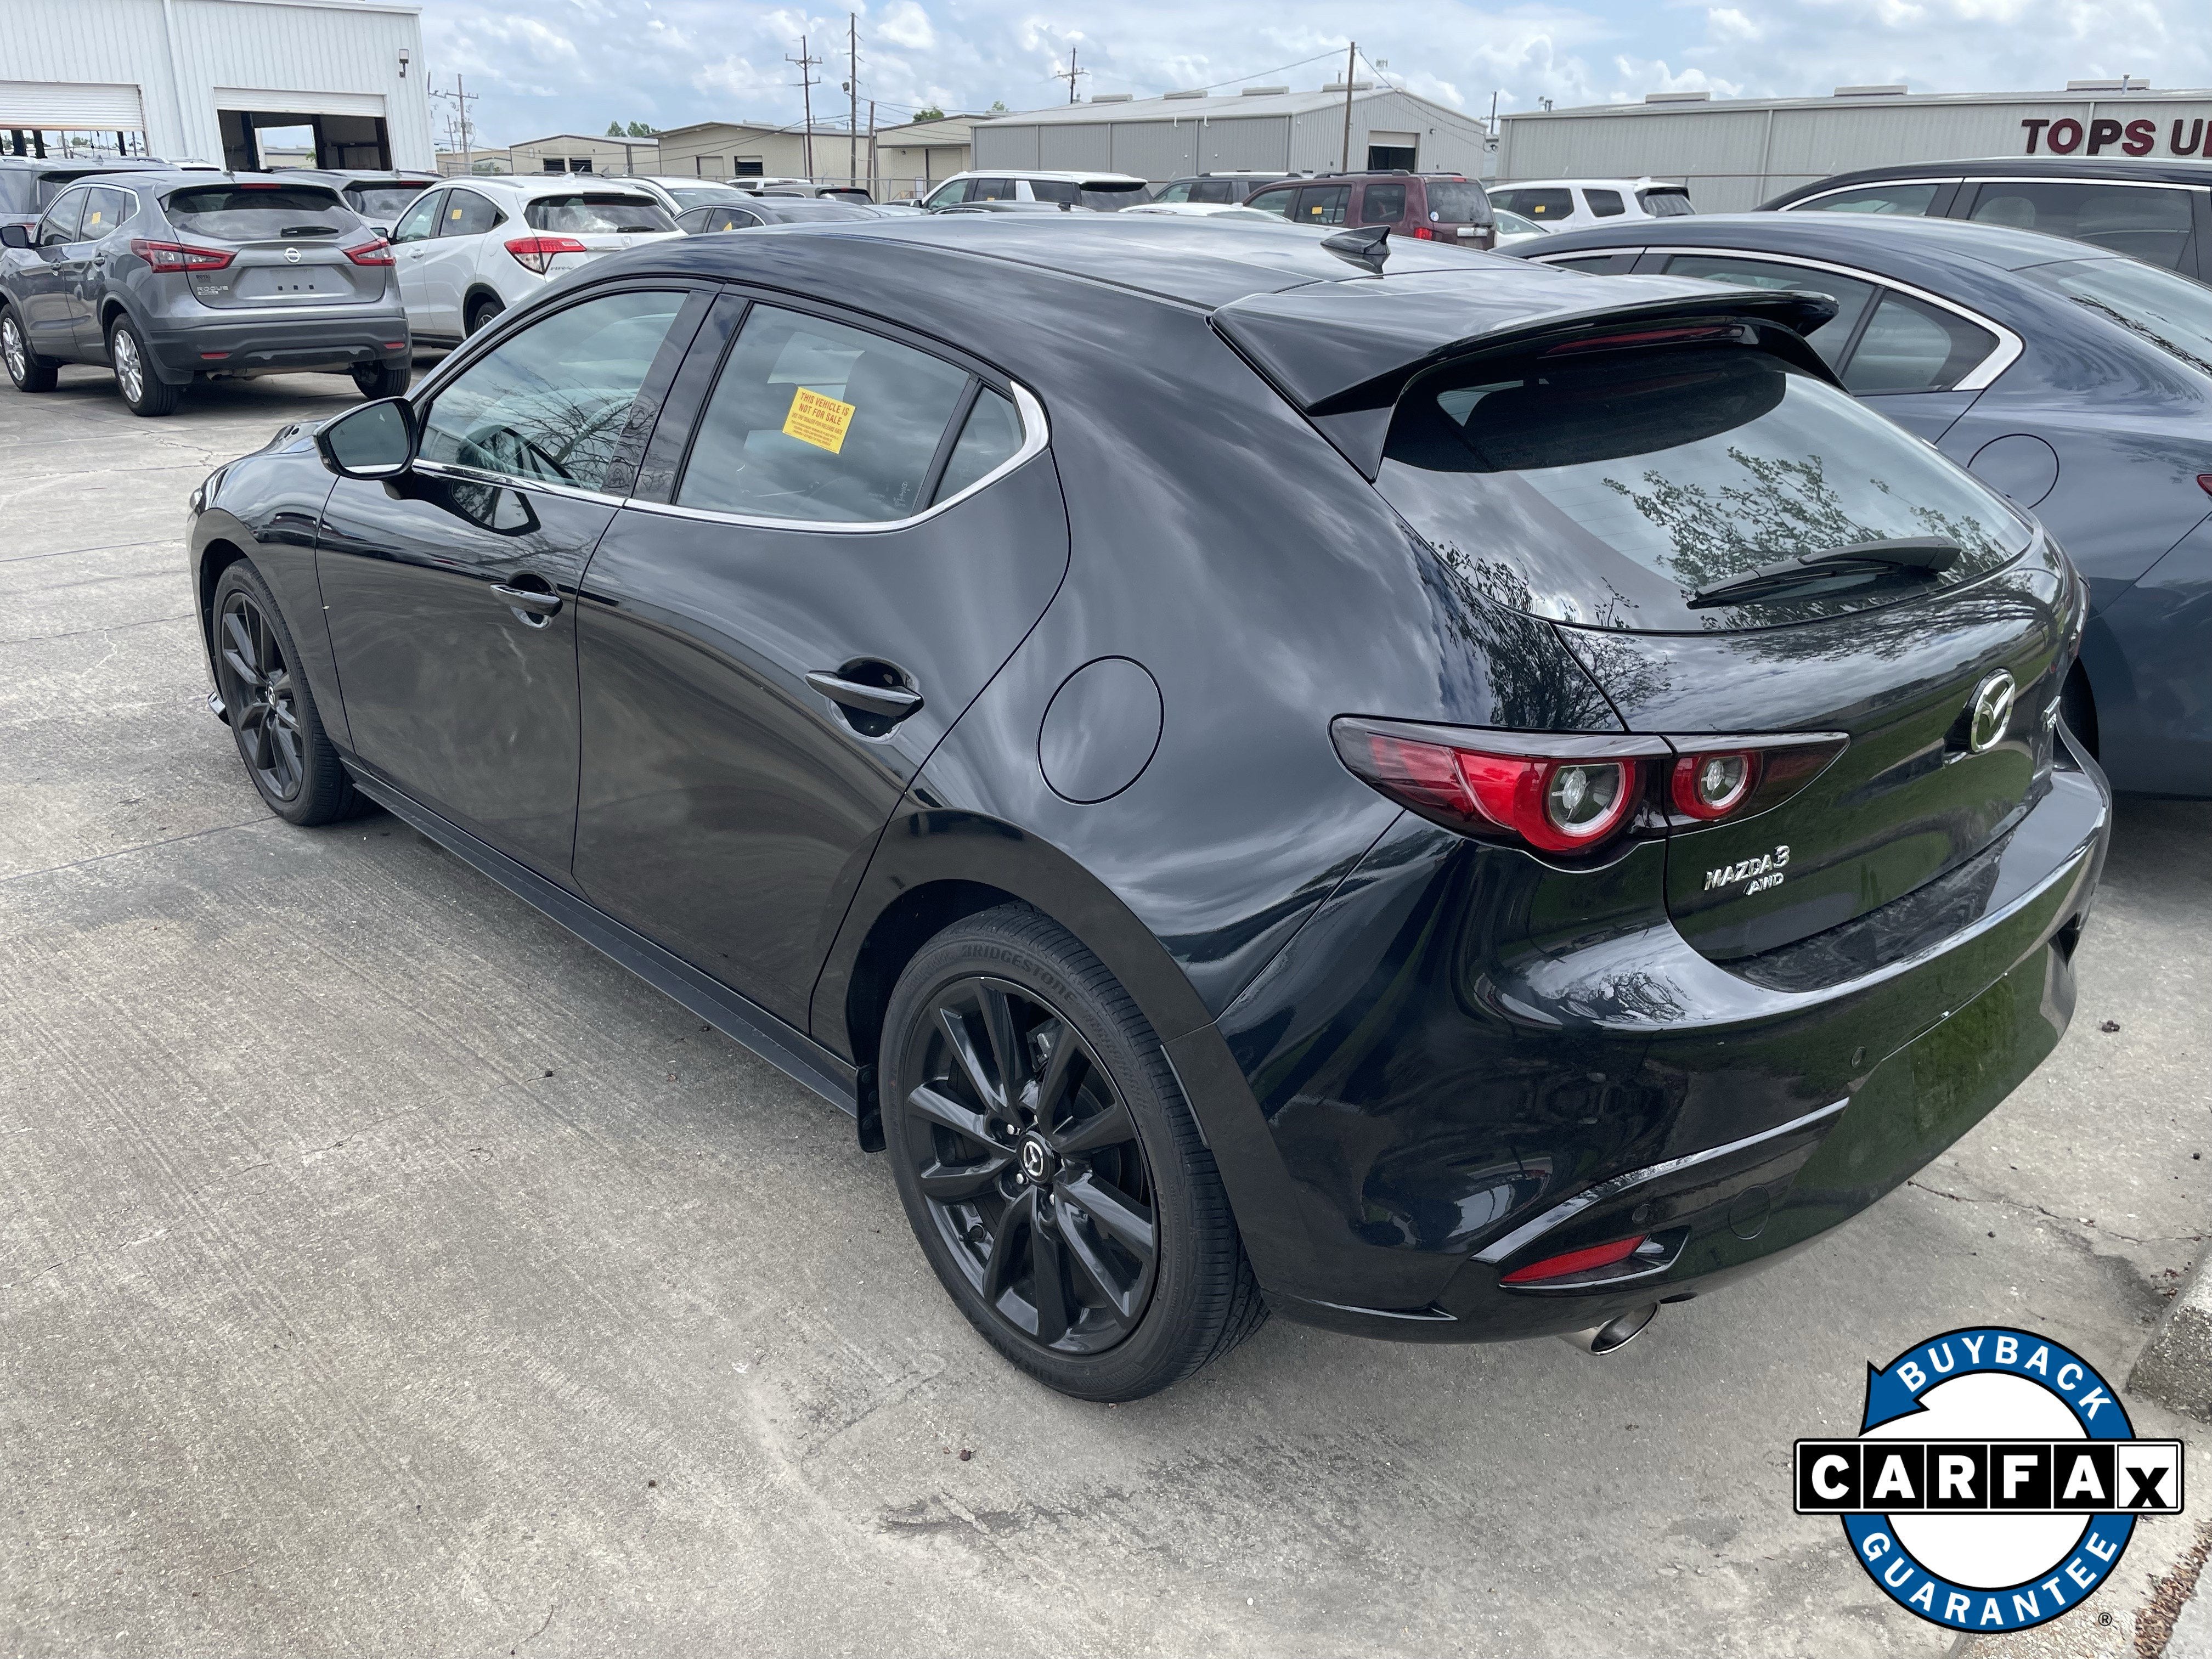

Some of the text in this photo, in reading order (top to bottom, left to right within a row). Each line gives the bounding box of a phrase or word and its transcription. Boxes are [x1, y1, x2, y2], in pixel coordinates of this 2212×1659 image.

[2021, 118, 2155, 156] TOPS
[798, 403, 842, 425] NOT FOR SALE
[799, 392, 849, 416] THIS VEHICLE IS
[1703, 845, 1790, 891] MAZDA3
[1743, 872, 1784, 895] AWD
[961, 944, 1079, 1005] BRIDGESTONE
